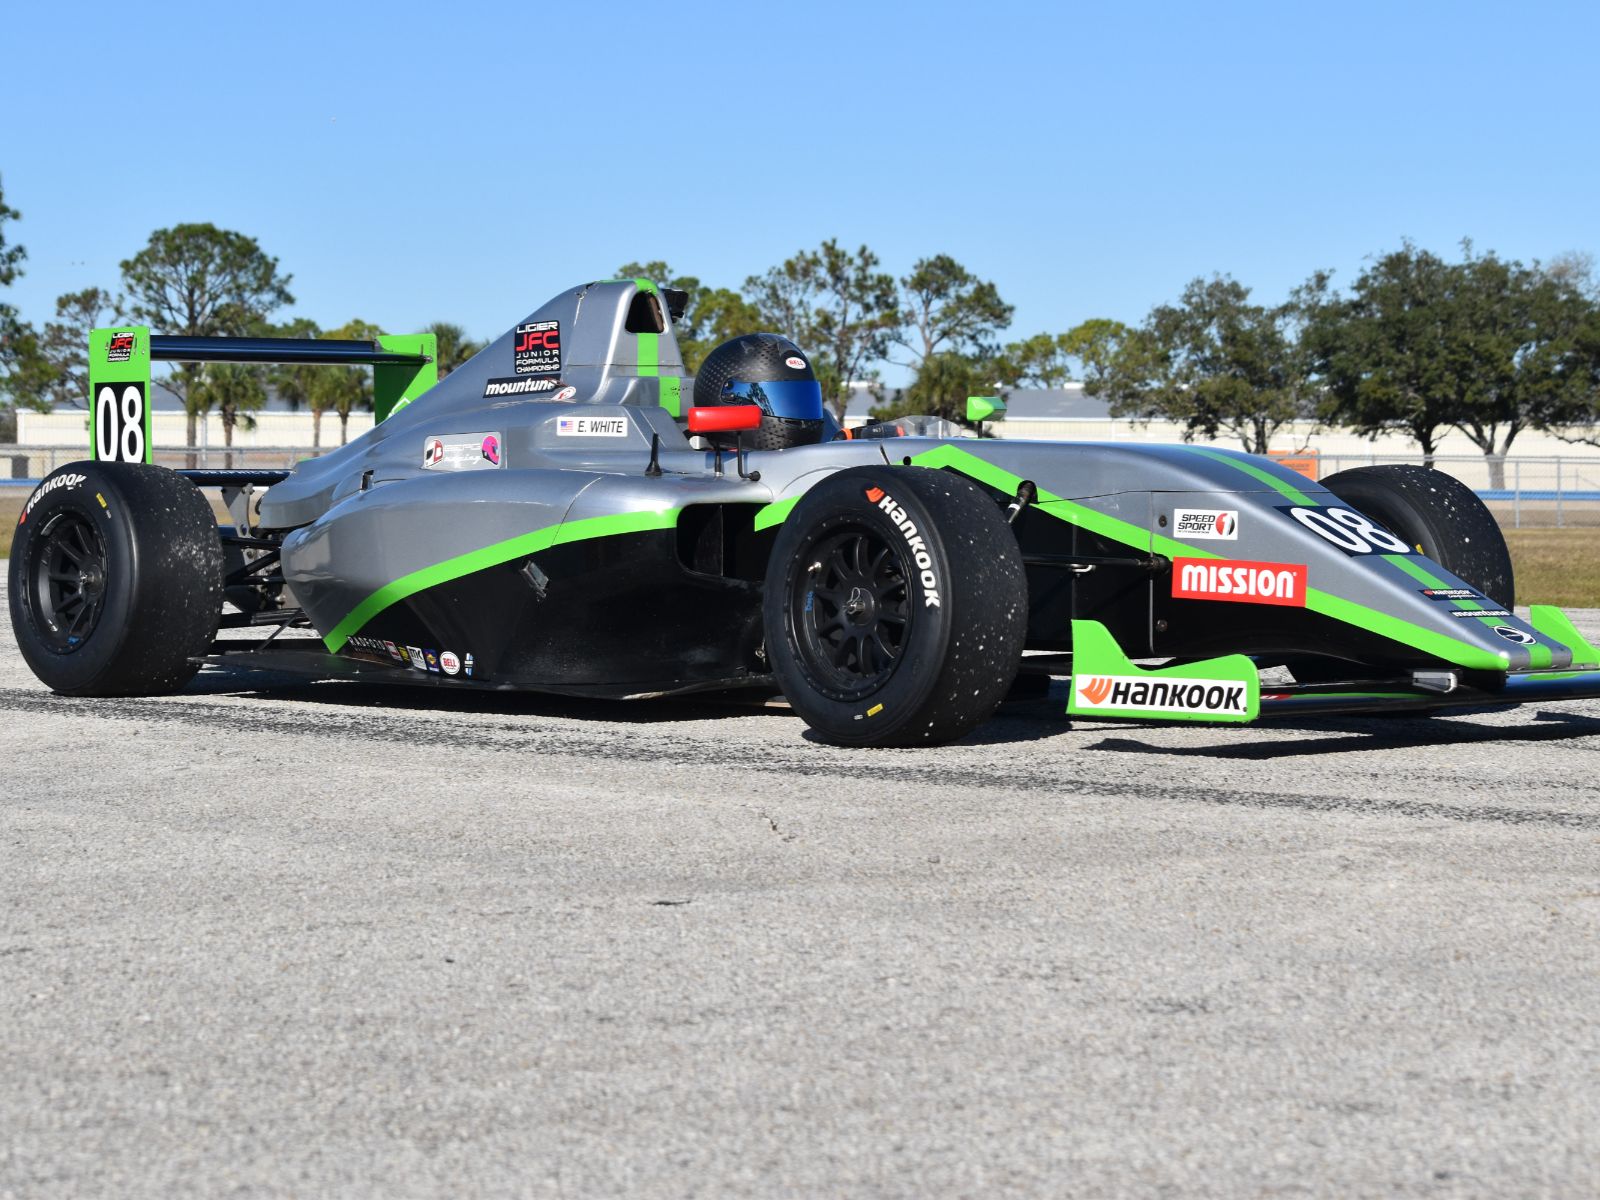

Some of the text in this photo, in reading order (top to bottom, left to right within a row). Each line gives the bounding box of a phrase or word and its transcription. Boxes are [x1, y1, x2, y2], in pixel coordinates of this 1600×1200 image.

[516, 321, 558, 333] LIGIER
[110, 338, 133, 349] JFC
[516, 331, 559, 351] JFC
[516, 349, 559, 358] JUNIOR
[516, 357, 560, 366] FORMULA
[516, 364, 560, 374] CHAMPIONSHIP
[485, 378, 557, 395] mountune
[96, 386, 144, 464] 08
[577, 420, 624, 433] E. WHITE
[1181, 513, 1216, 523] SPEED
[1177, 522, 1214, 531] SPORT
[1290, 507, 1411, 554] 08
[1181, 564, 1295, 599] MISSION
[442, 657, 457, 668] BELL
